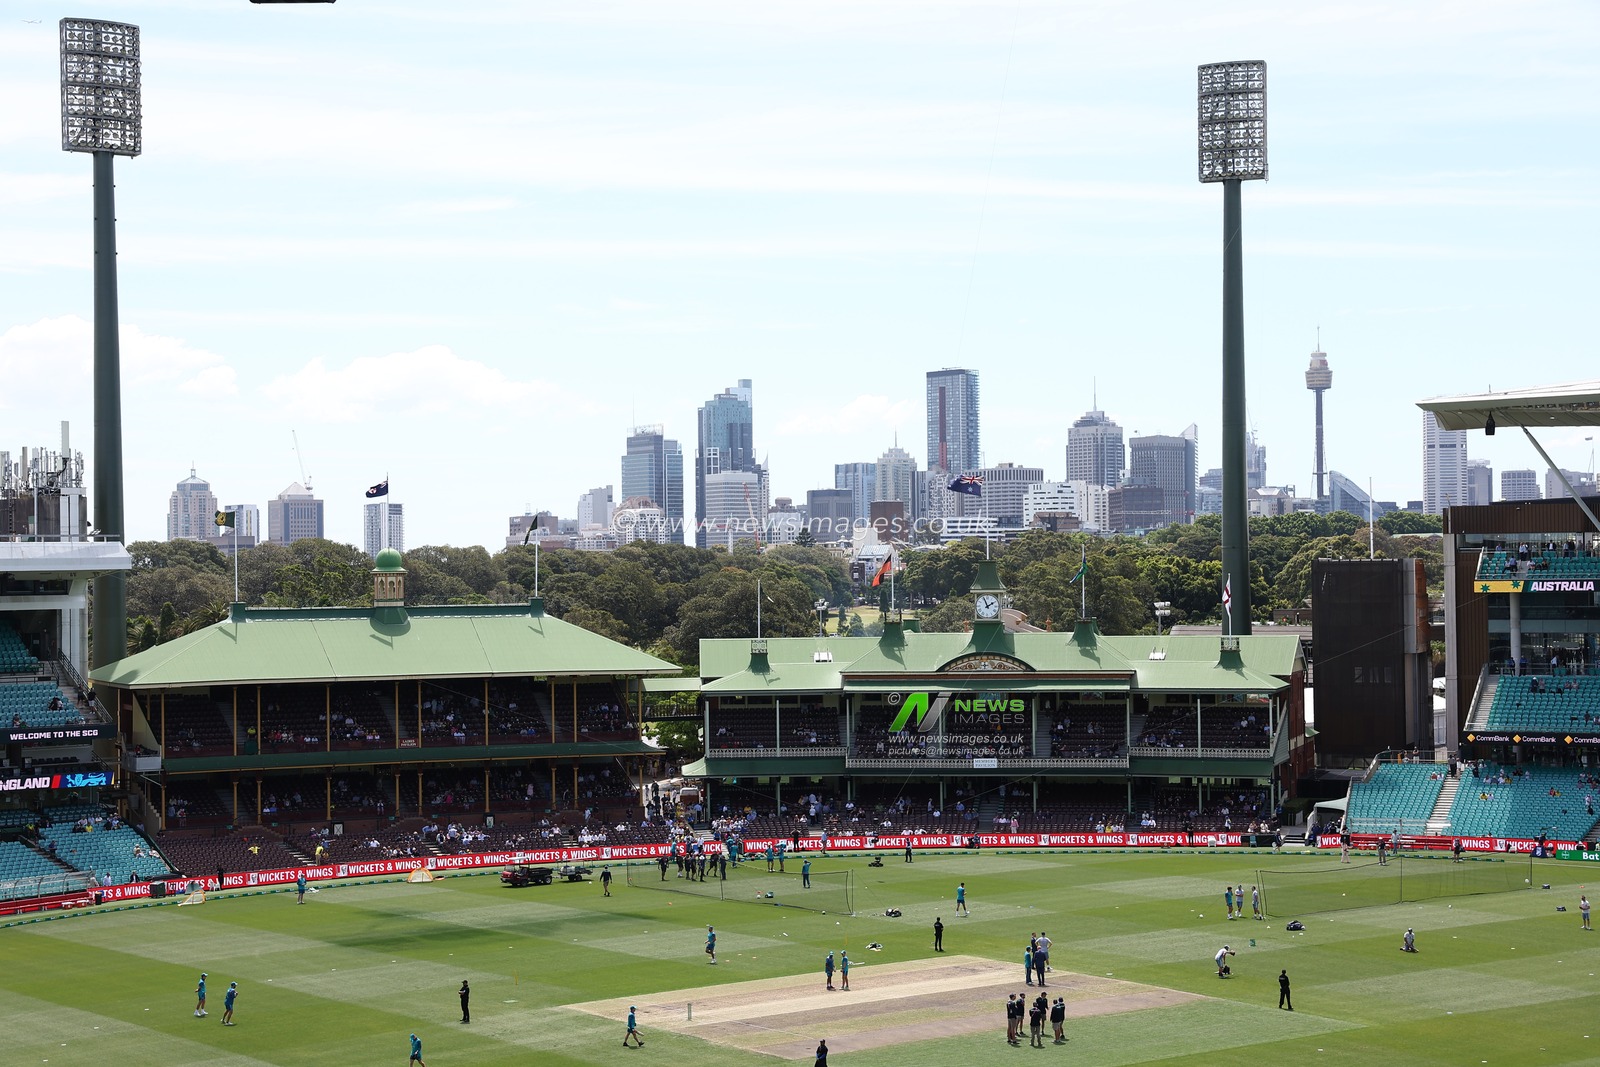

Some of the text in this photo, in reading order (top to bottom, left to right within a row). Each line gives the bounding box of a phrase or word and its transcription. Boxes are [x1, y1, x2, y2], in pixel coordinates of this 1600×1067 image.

[1531, 581, 1595, 591] AUSTRALIA
[10, 732, 51, 740] WELCOME
[826, 839, 832, 847] &
[834, 838, 861, 847] WINGS
[876, 836, 948, 846] WICKET & WINGS
[1000, 836, 1006, 844] &
[1008, 836, 1035, 844] WINGS
[1050, 835, 1123, 844] WICKETS & WINGS
[1138, 835, 1175, 844] WICKETS
[1177, 835, 1183, 844] &
[1461, 839, 1490, 849] WINGS
[525, 849, 597, 862] WICKETS & WINGS
[612, 847, 648, 857] WICKETS
[650, 846, 656, 855] &
[437, 854, 510, 867] WICKETS & WINGS
[348, 860, 422, 874] WICKETS & WINGS
[258, 870, 295, 883] WICKETS
[306, 867, 333, 879] WINGS
[115, 887, 122, 897] &
